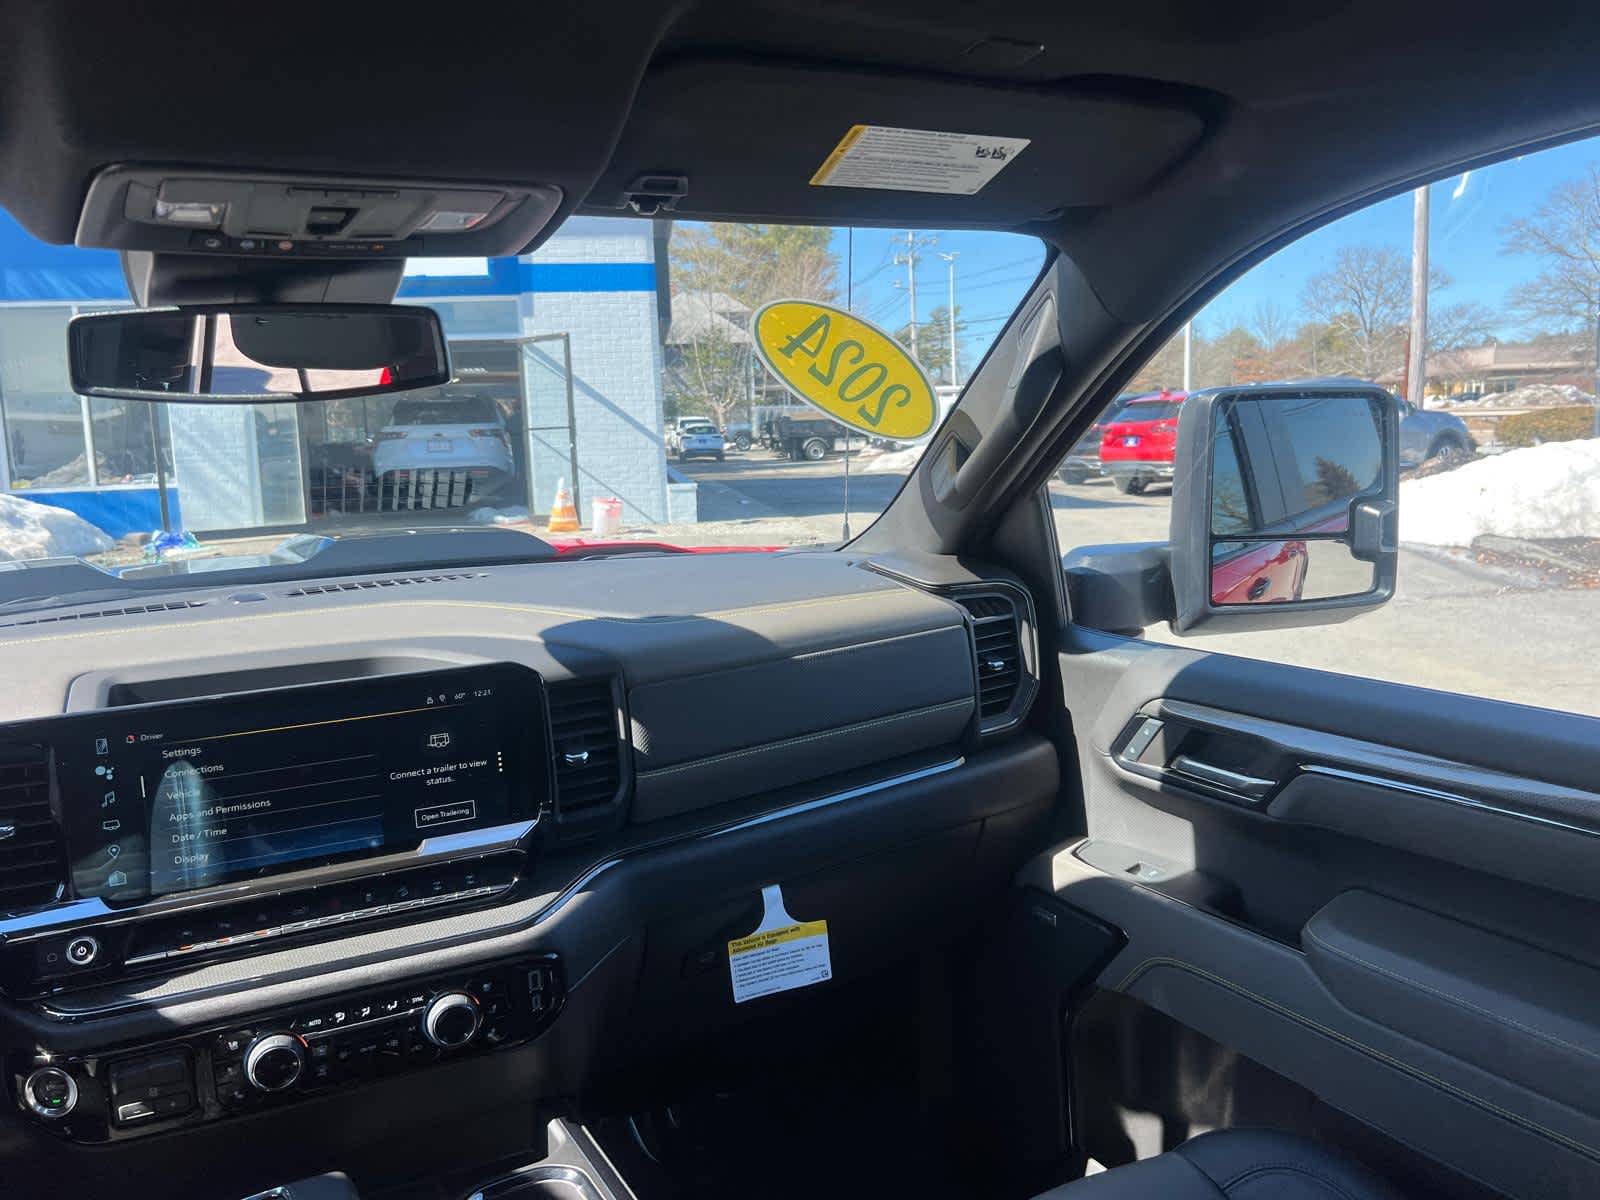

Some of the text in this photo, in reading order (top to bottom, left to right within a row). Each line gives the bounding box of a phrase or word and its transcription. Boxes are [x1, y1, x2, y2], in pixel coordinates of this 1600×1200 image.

[162, 747, 202, 759] Settings
[164, 764, 224, 778] Connections
[390, 769, 425, 780] Connect
[433, 764, 457, 774] trailer
[459, 762, 468, 770] to
[468, 760, 487, 768] view
[169, 812, 195, 822] Apps
[215, 800, 272, 815] Permissions
[421, 808, 470, 822] Open Trailering
[172, 833, 195, 844] Date
[203, 828, 228, 838] Time
[174, 853, 210, 866] Display
[308, 1018, 322, 1027] AUTO
